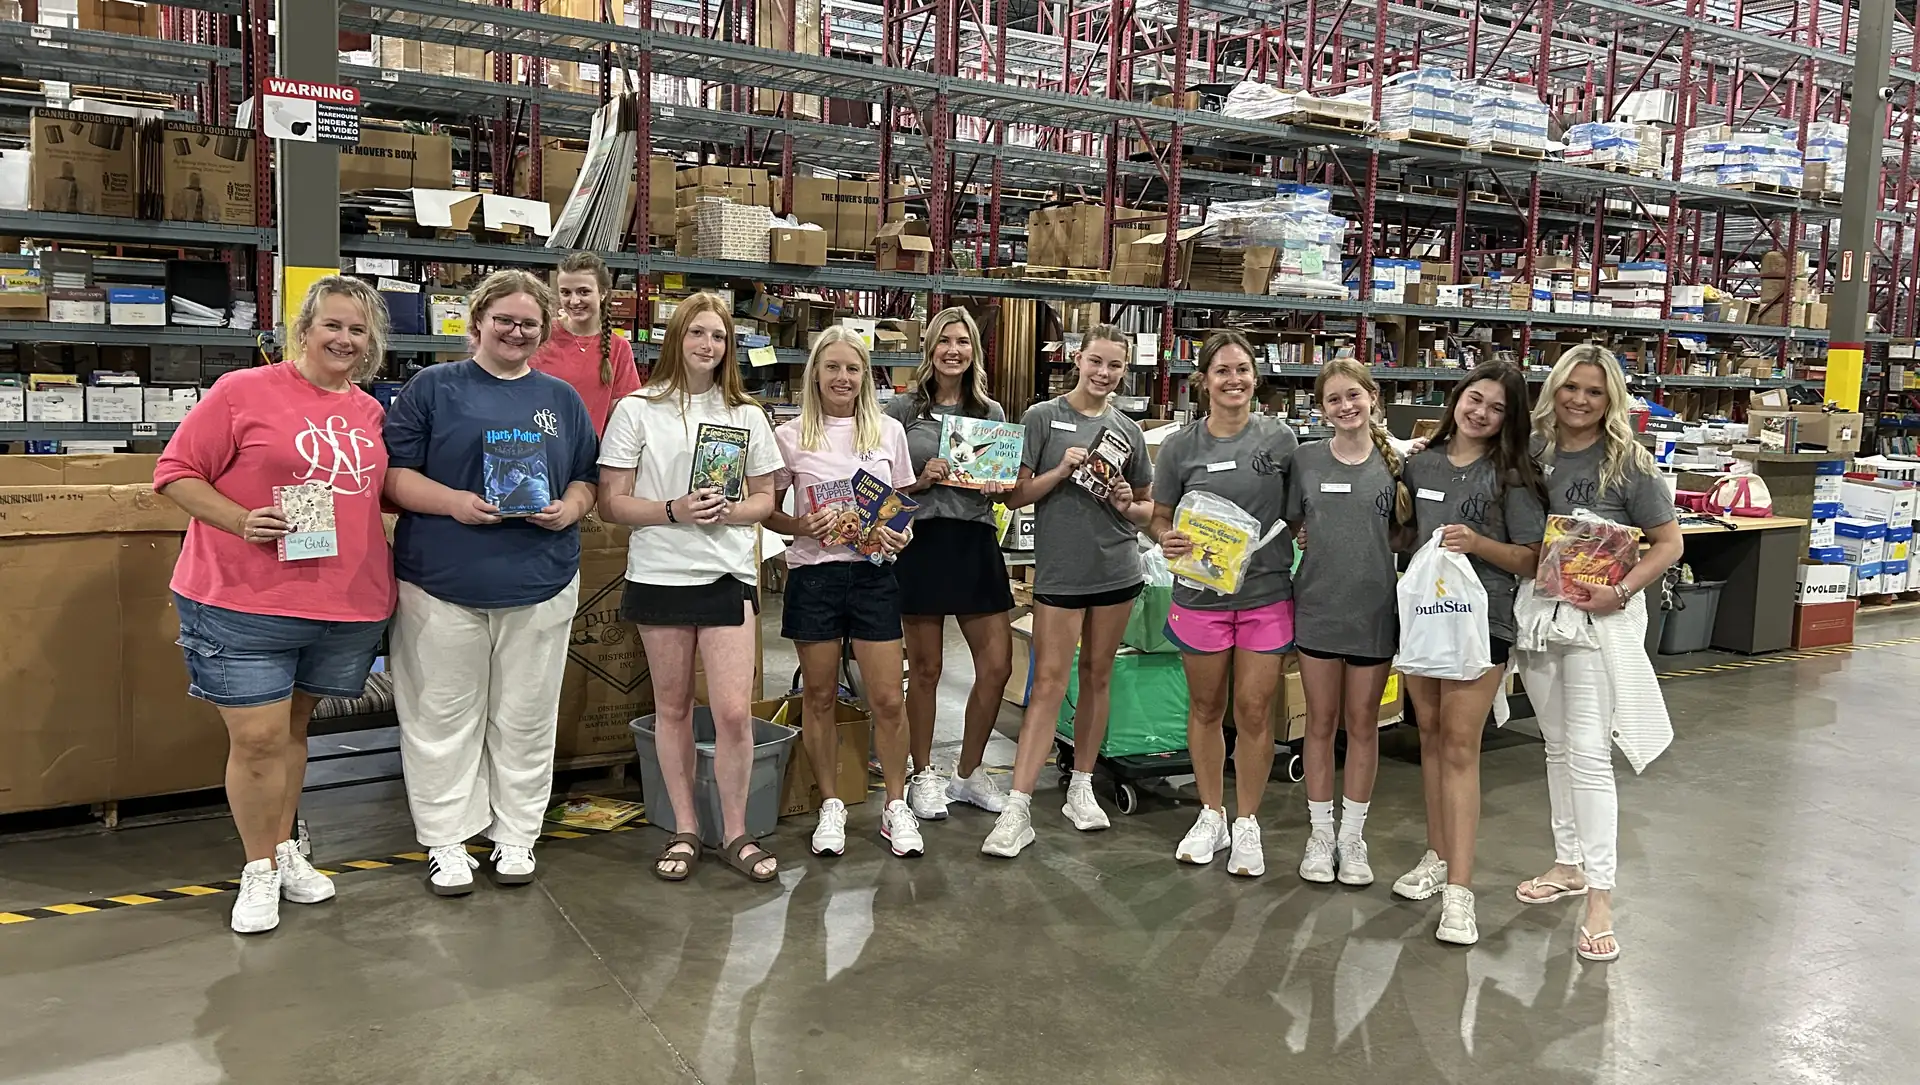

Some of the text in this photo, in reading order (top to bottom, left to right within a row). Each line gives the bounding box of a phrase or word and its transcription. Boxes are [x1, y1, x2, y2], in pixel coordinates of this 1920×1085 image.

[269, 80, 354, 101] WARNING
[38, 109, 129, 126] CANNED FOOD DRIVE
[318, 111, 358, 120] WAREHOUSE
[318, 118, 347, 127] UNDER
[167, 122, 252, 138] CANNED FOOD DRIVE
[318, 133, 359, 141] SURVEILLANCE
[332, 127, 359, 135] VIDEO
[339, 144, 418, 161] THE MOVER'S BOXX
[821, 193, 834, 202] THE
[835, 194, 862, 204] MOVER'S
[485, 428, 542, 444] Harry Potter
[999, 441, 1016, 450] DOG
[994, 450, 1019, 459] HOUSE
[815, 480, 850, 494] PALACE
[860, 474, 884, 494] llama
[816, 488, 852, 502] PUPPIES
[856, 481, 880, 502] llama
[856, 495, 871, 506] red
[304, 536, 330, 550] Girls
